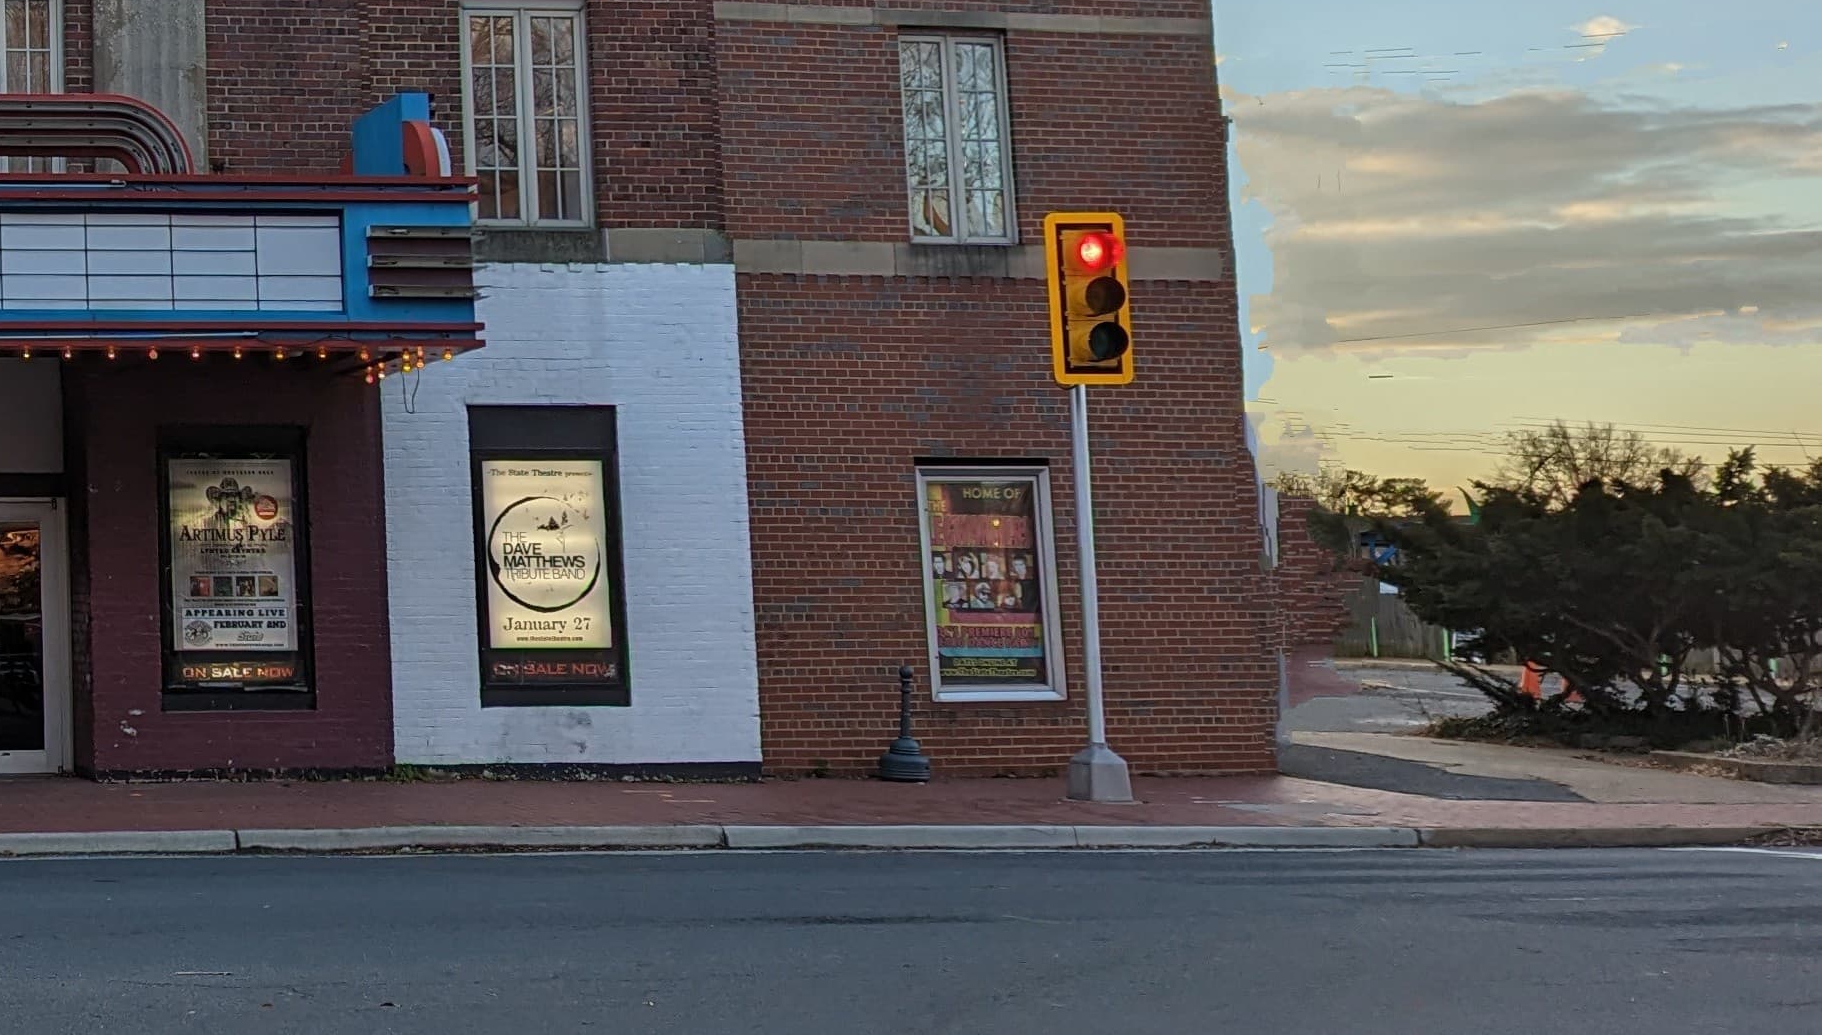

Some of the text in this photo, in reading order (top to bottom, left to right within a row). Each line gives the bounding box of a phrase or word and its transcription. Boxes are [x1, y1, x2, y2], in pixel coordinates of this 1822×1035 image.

[962, 488, 1021, 499] HOME OF
[179, 525, 286, 542] ARTIMUS PYLE
[502, 532, 528, 542] THE
[502, 542, 542, 555] DAVE
[504, 555, 586, 568] MATTHEWS
[505, 568, 586, 580] TRIBUTE BAND
[185, 609, 286, 617] APPEARING LIVE
[214, 620, 286, 628] FEBRUARY 2ND
[503, 617, 592, 633] January 27
[182, 666, 293, 678] ON SALE NOW
[522, 662, 567, 676] SALE
